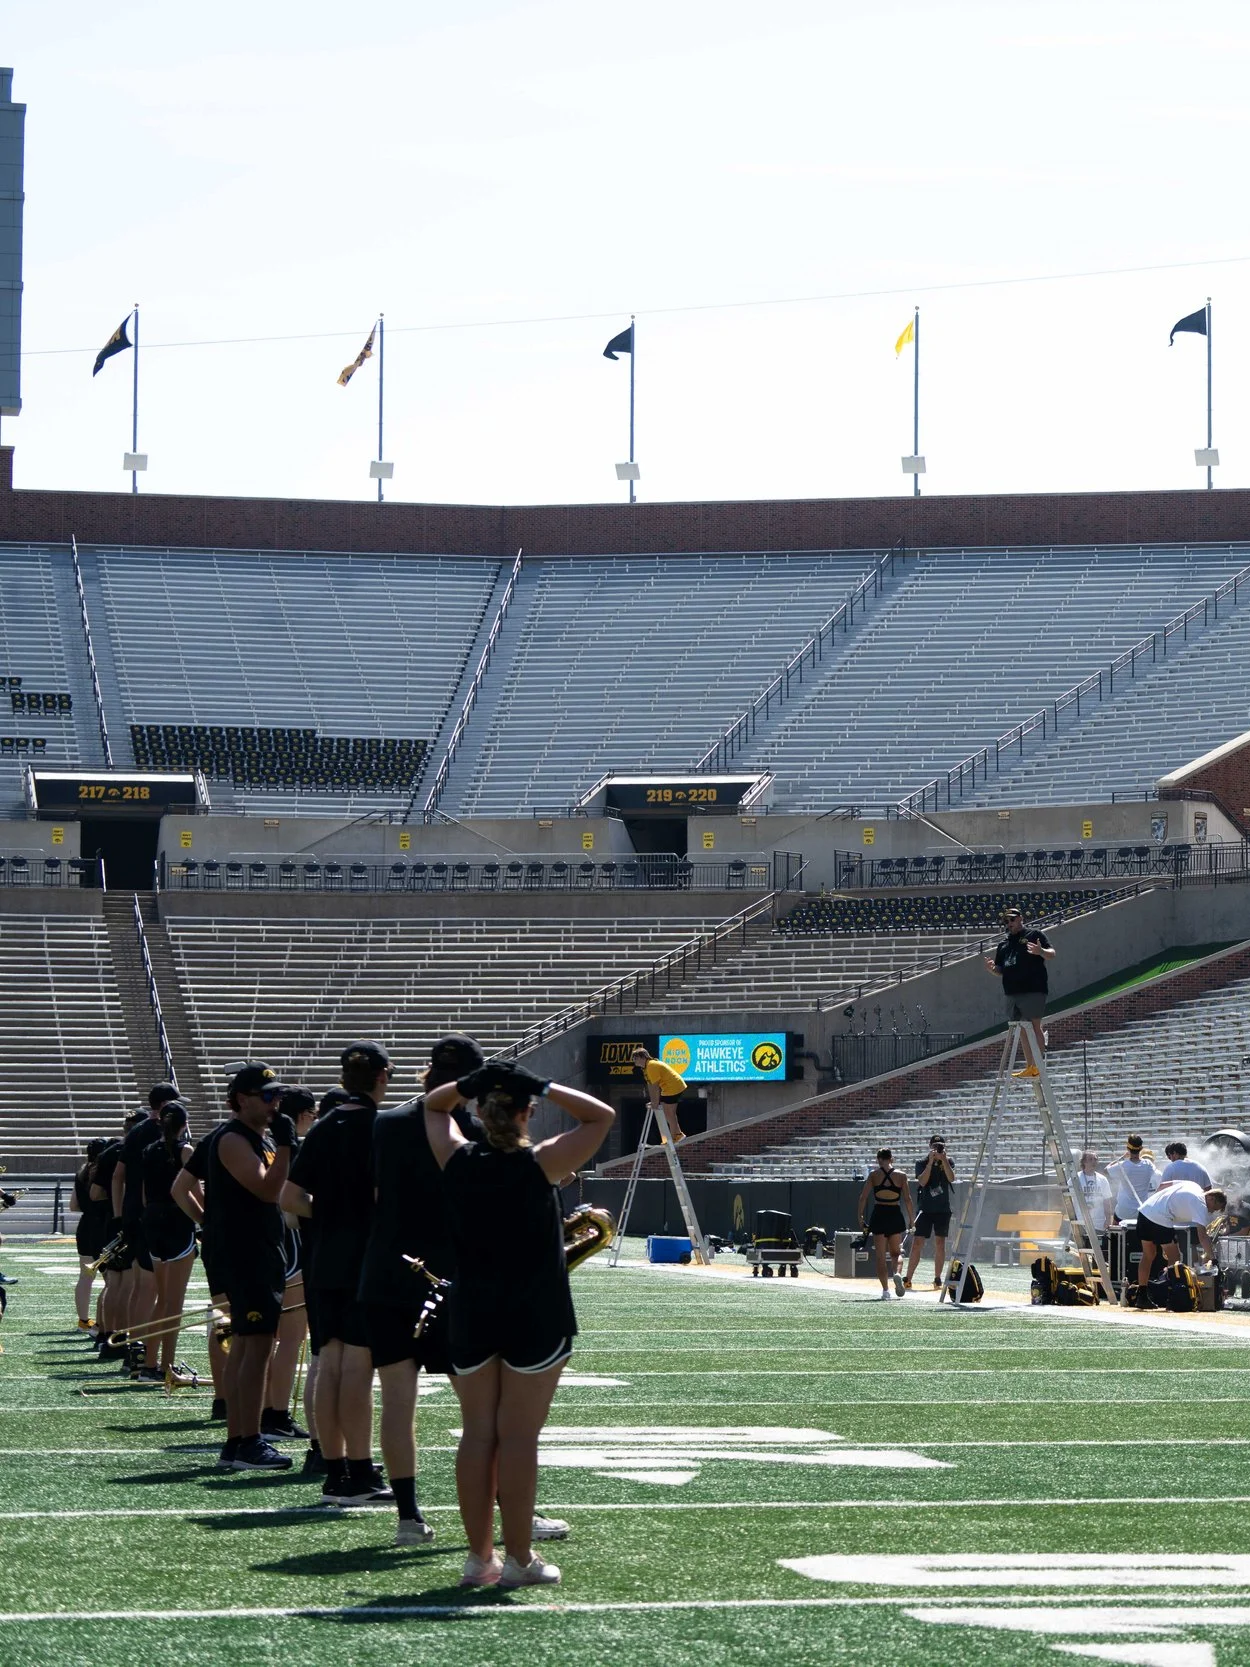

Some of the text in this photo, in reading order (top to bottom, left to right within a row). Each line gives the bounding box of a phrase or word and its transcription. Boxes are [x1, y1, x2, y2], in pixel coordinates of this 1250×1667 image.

[78, 785, 150, 800] 217 218
[646, 788, 717, 802] 219 220
[696, 1047, 744, 1060] HAWKEYE
[665, 1057, 688, 1065] NOON
[694, 1060, 746, 1073] ATHLETICS
